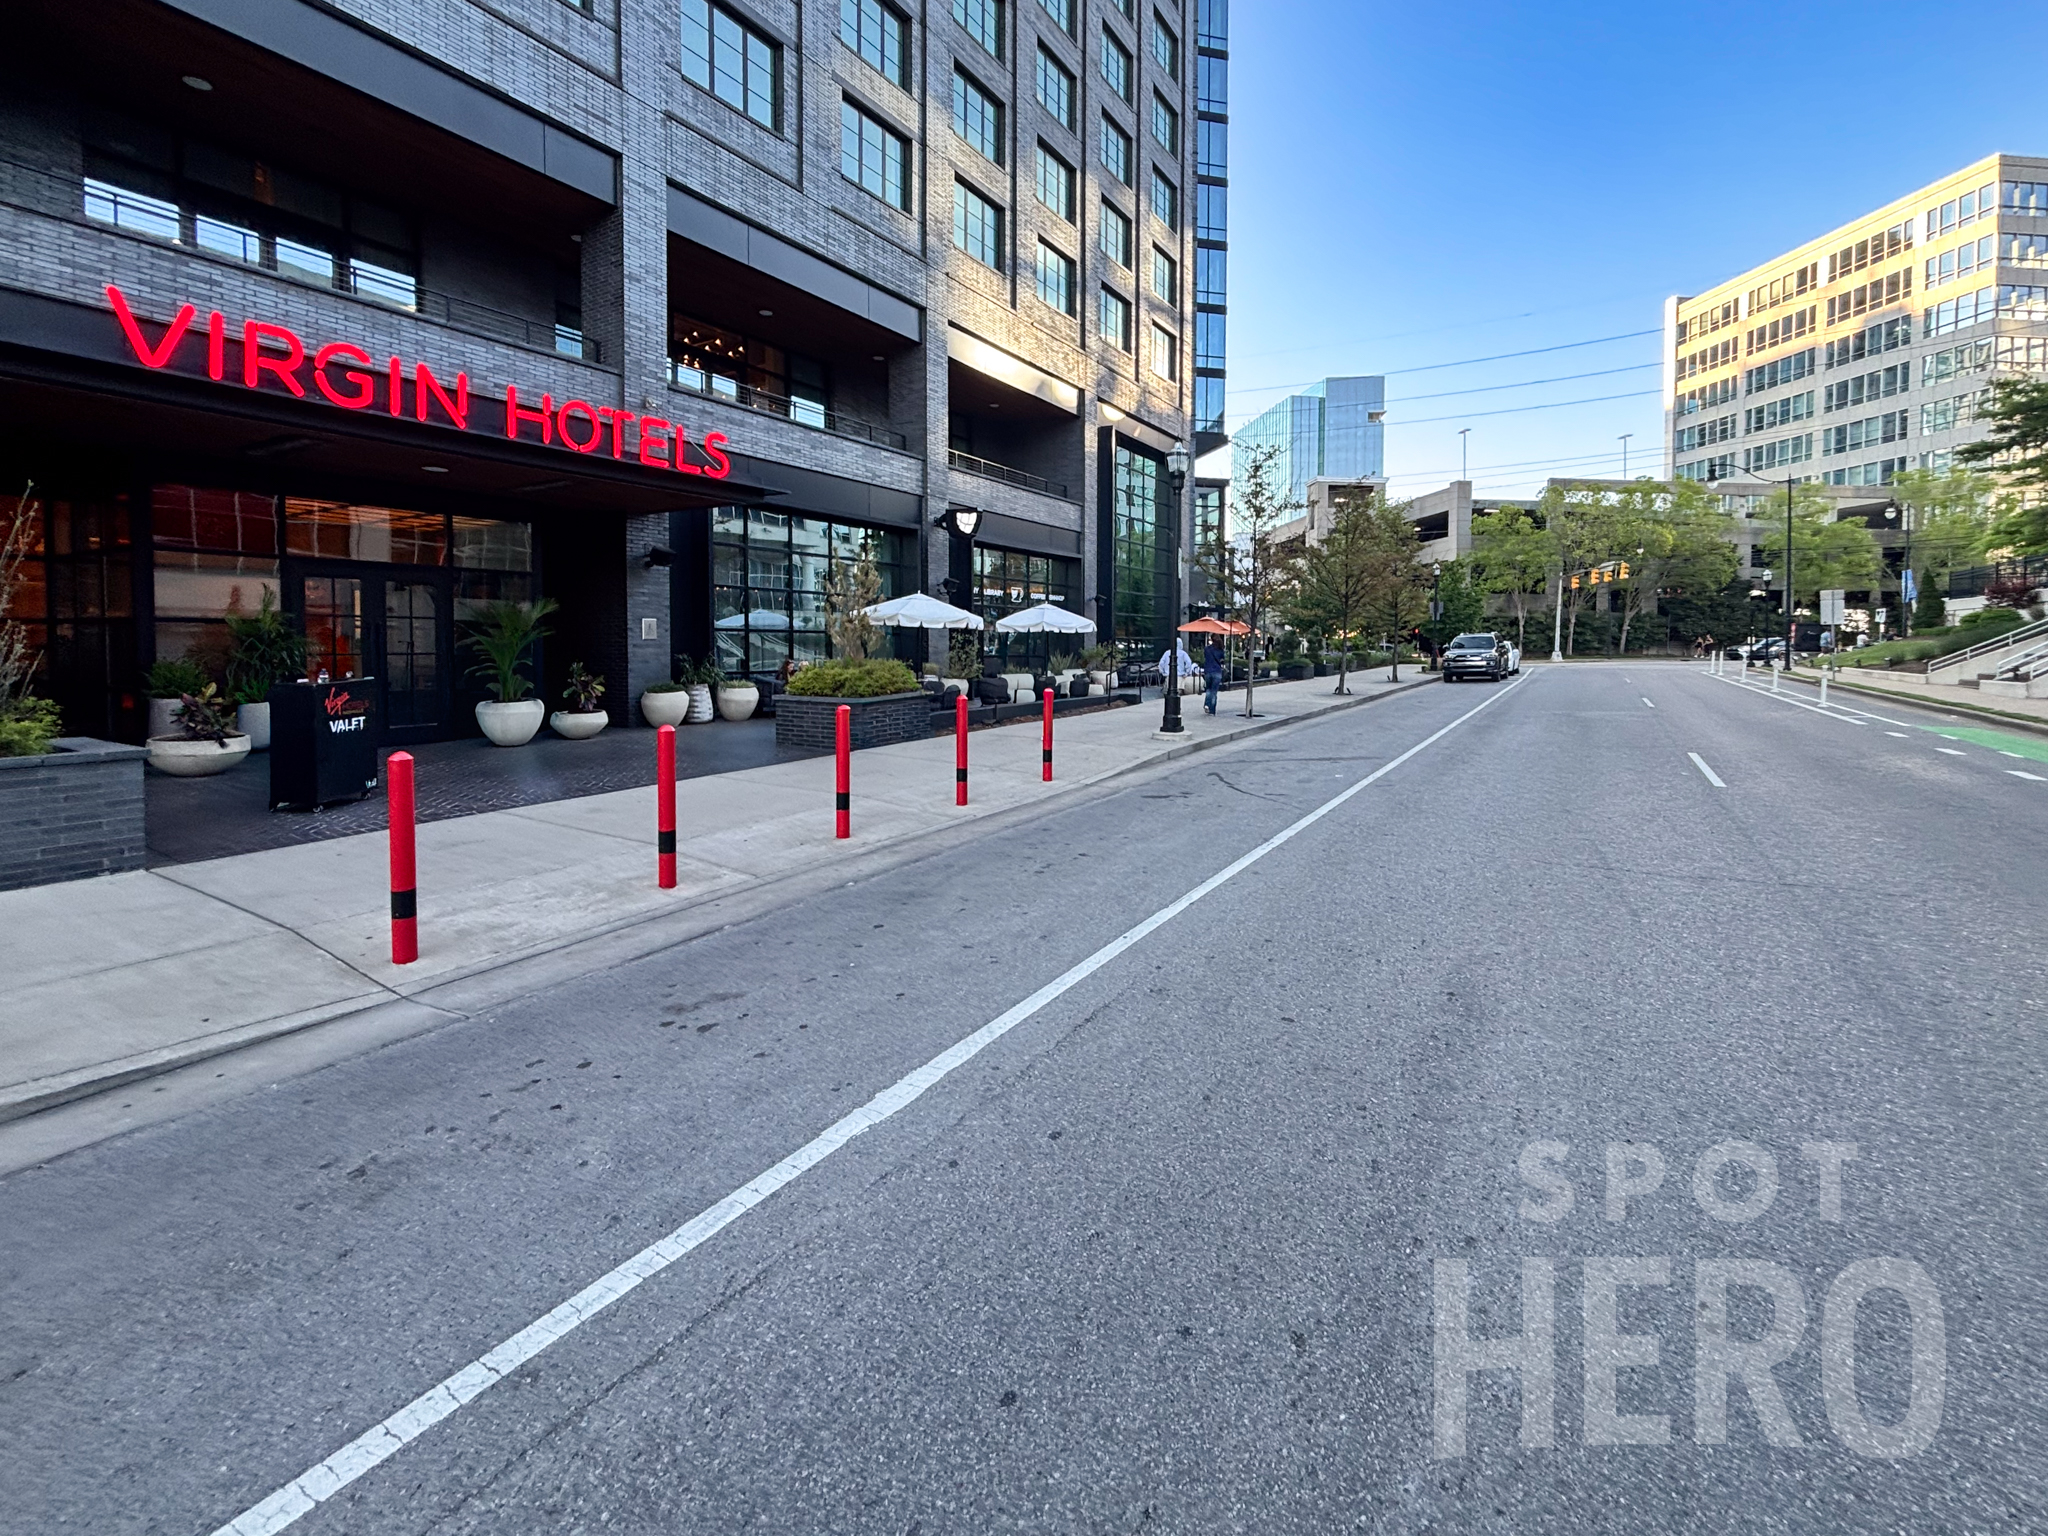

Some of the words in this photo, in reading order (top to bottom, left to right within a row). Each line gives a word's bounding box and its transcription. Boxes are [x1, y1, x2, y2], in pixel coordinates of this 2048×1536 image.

[105, 285, 470, 430] VIRGIN
[506, 385, 731, 480] HOTELS
[983, 588, 1004, 597] LIBRARY
[329, 716, 366, 733] VALET
